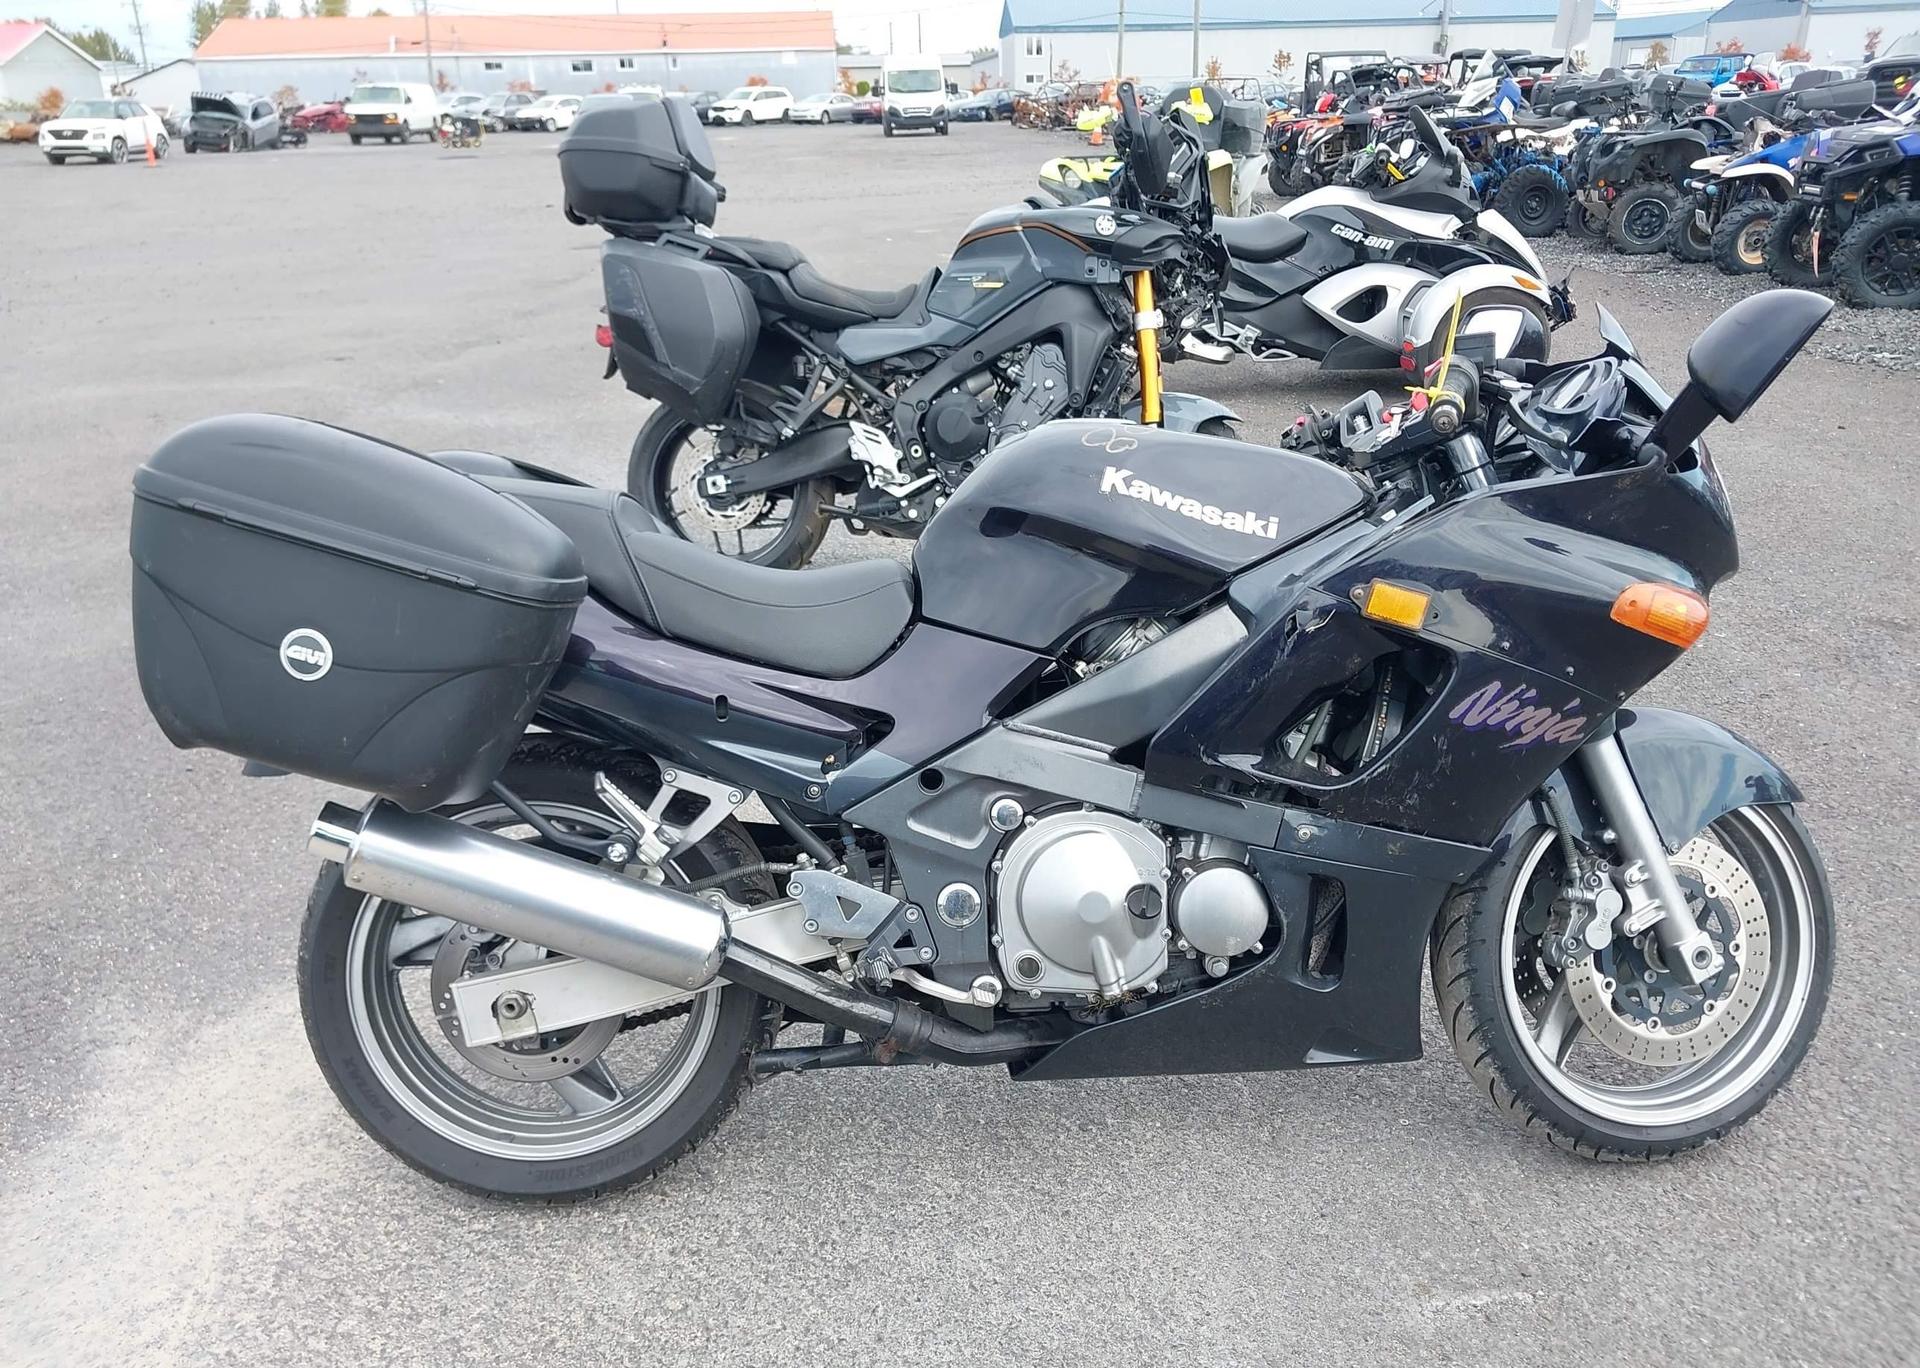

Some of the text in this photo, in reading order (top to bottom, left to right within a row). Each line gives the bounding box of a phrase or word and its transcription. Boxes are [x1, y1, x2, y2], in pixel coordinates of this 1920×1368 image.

[1099, 466, 1280, 540] Kawasaki
[285, 644, 326, 667] GIVI
[1448, 680, 1588, 750] Ninja
